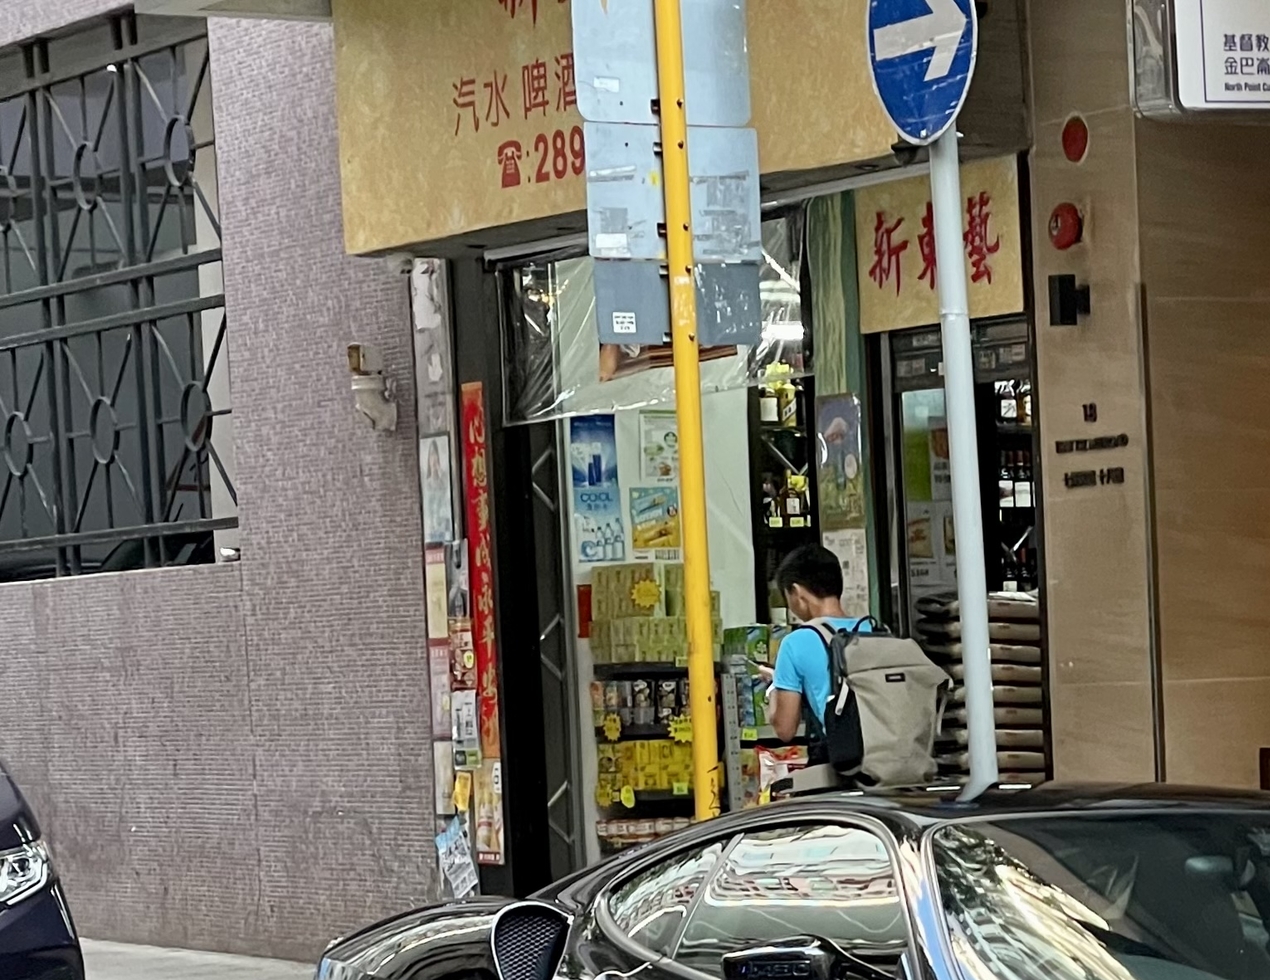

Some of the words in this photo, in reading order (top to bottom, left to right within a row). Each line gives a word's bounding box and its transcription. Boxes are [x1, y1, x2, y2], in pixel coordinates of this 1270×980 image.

[1223, 33, 1269, 51] 基督教
[452, 69, 510, 136] 汽水
[522, 52, 577, 120] 啤酒
[1224, 83, 1242, 91] North
[1244, 83, 1261, 91] Point
